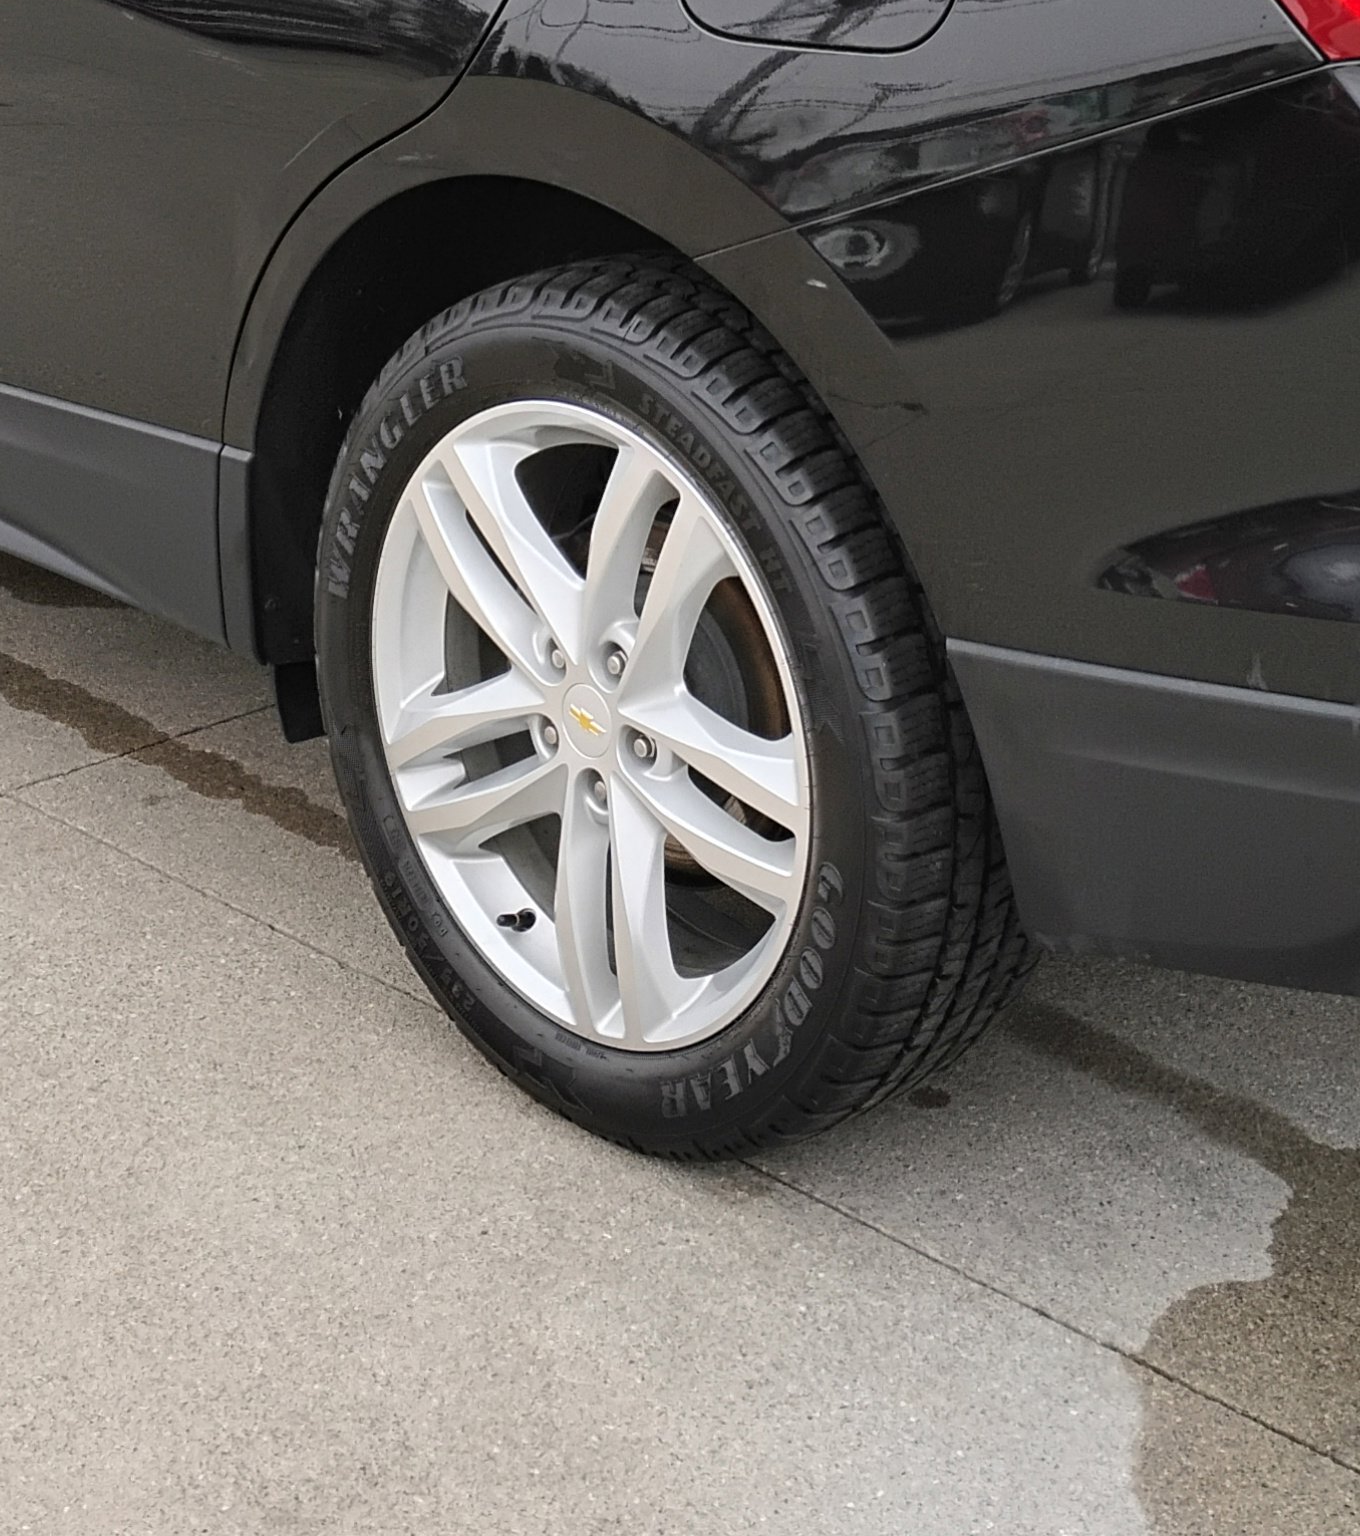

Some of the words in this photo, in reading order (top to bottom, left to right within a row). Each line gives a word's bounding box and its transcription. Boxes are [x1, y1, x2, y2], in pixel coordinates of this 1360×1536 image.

[327, 355, 468, 600] WRANGLER
[639, 391, 762, 536] STEADFAST
[660, 861, 844, 1118] GOODYEAR
